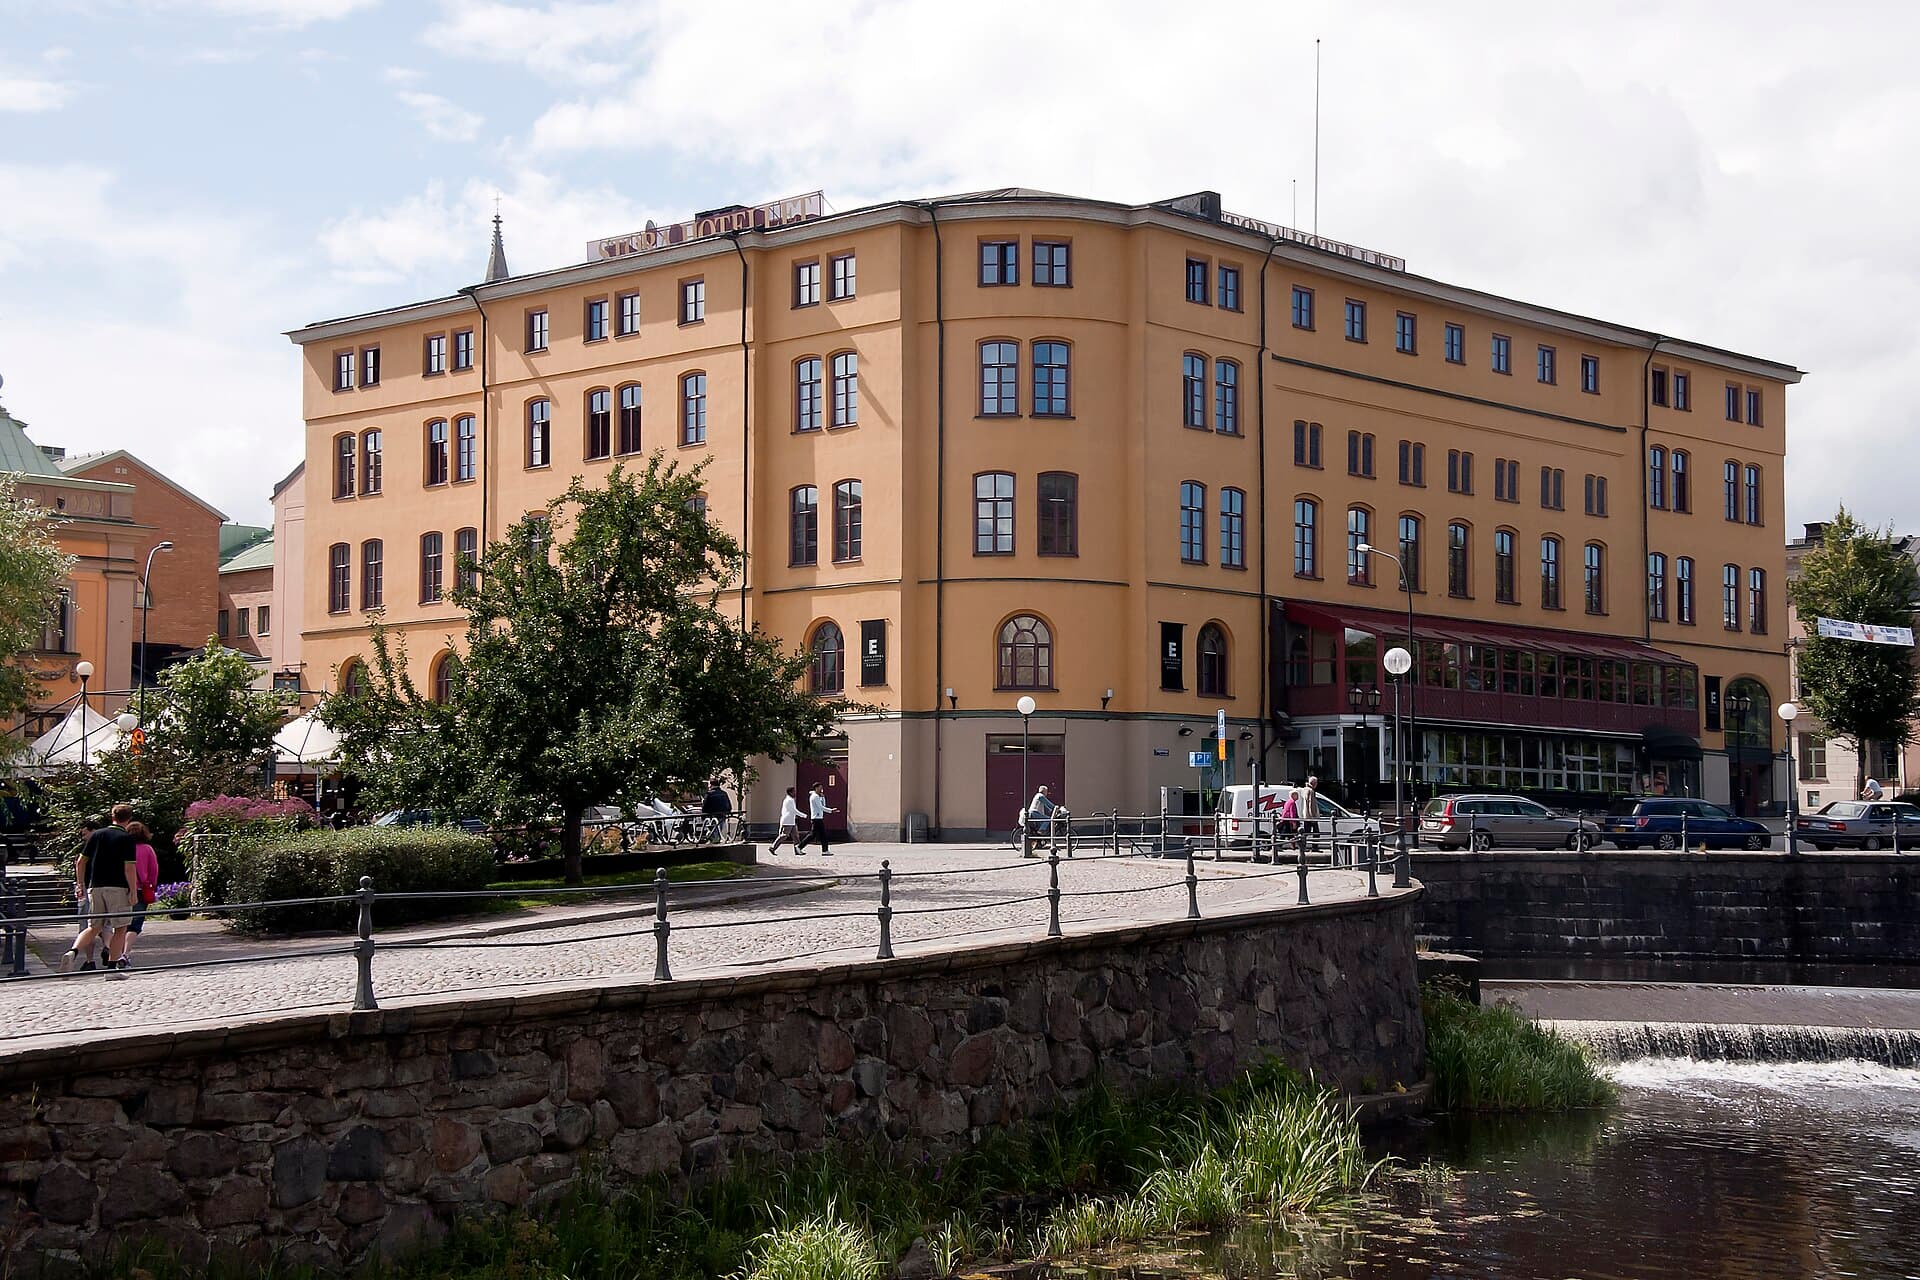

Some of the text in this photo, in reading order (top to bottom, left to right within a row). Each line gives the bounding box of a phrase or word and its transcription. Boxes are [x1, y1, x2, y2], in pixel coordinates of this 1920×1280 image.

[868, 639, 878, 655] E
[1168, 641, 1177, 657] E
[1710, 691, 1717, 704] E
